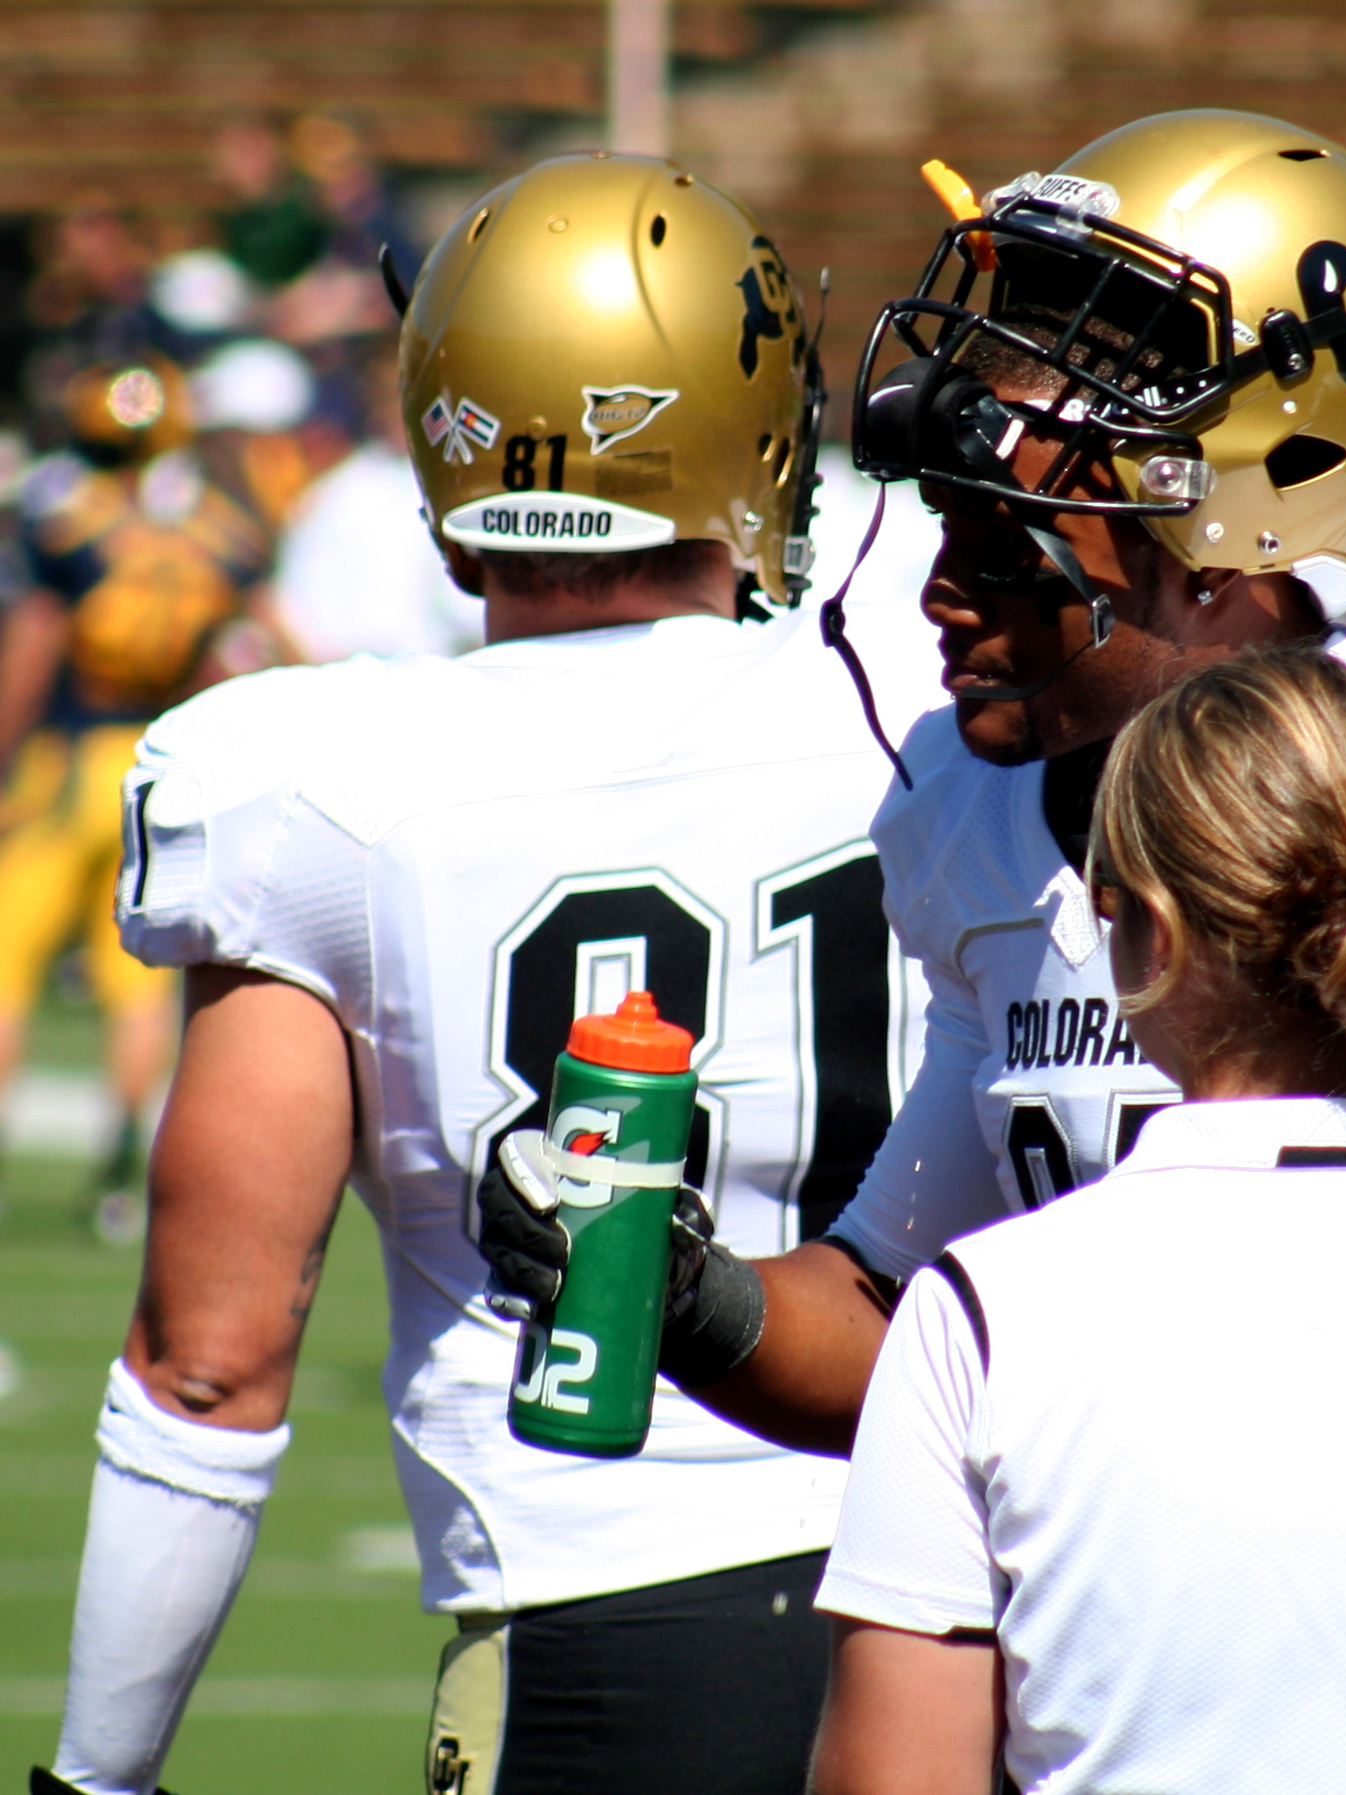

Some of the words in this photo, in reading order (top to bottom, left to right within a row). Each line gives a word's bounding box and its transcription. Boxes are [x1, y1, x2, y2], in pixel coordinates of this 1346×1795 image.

[502, 434, 567, 492] 81
[482, 508, 611, 538] COLORADO
[1005, 998, 1151, 1070] COLORA
